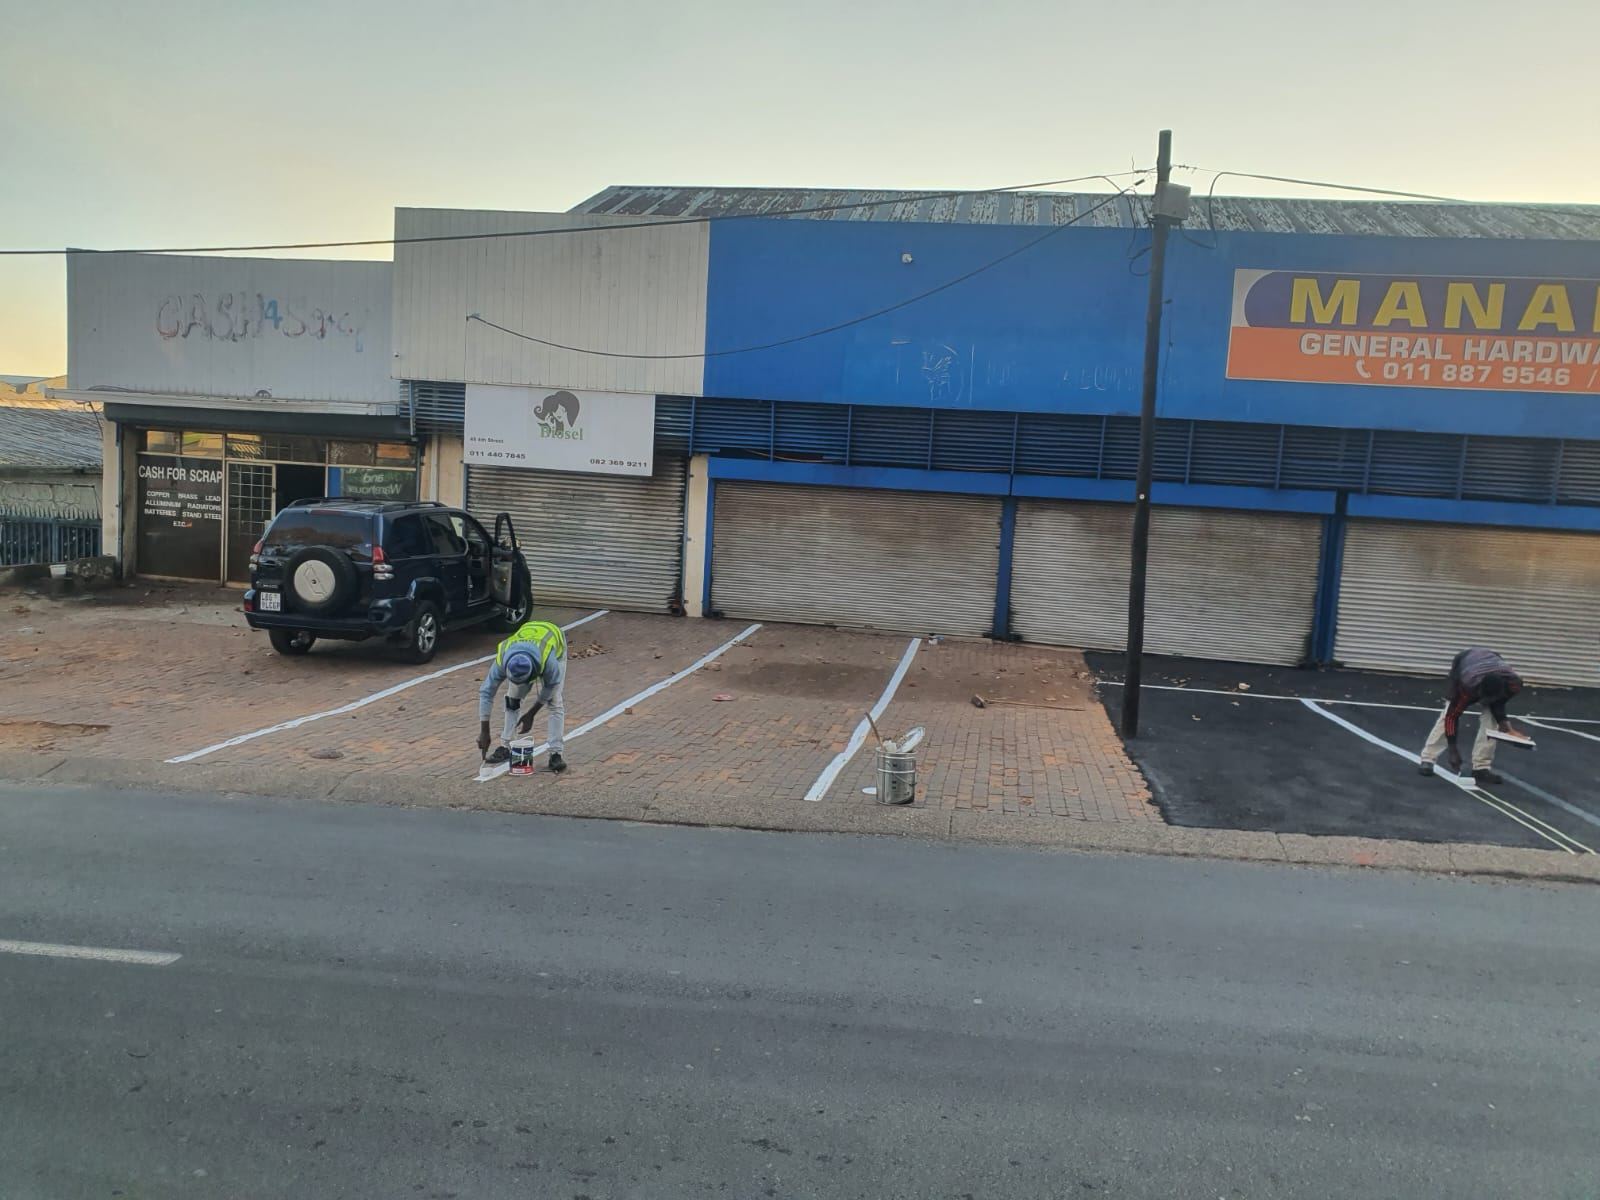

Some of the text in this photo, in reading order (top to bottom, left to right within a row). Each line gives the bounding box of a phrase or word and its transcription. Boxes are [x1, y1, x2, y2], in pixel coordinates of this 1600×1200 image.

[1290, 277, 1600, 333] MANA
[1299, 332, 1452, 361] GENERAL
[1383, 361, 1431, 380] 011
[1442, 364, 1492, 383] 887
[1502, 366, 1571, 386] 9546
[138, 465, 223, 483] CASH FOR SCRAP
[146, 490, 170, 498] COPPER
[178, 492, 198, 500] BRASS
[144, 508, 177, 517] BATTERIES
[187, 502, 222, 511] RADIATORS
